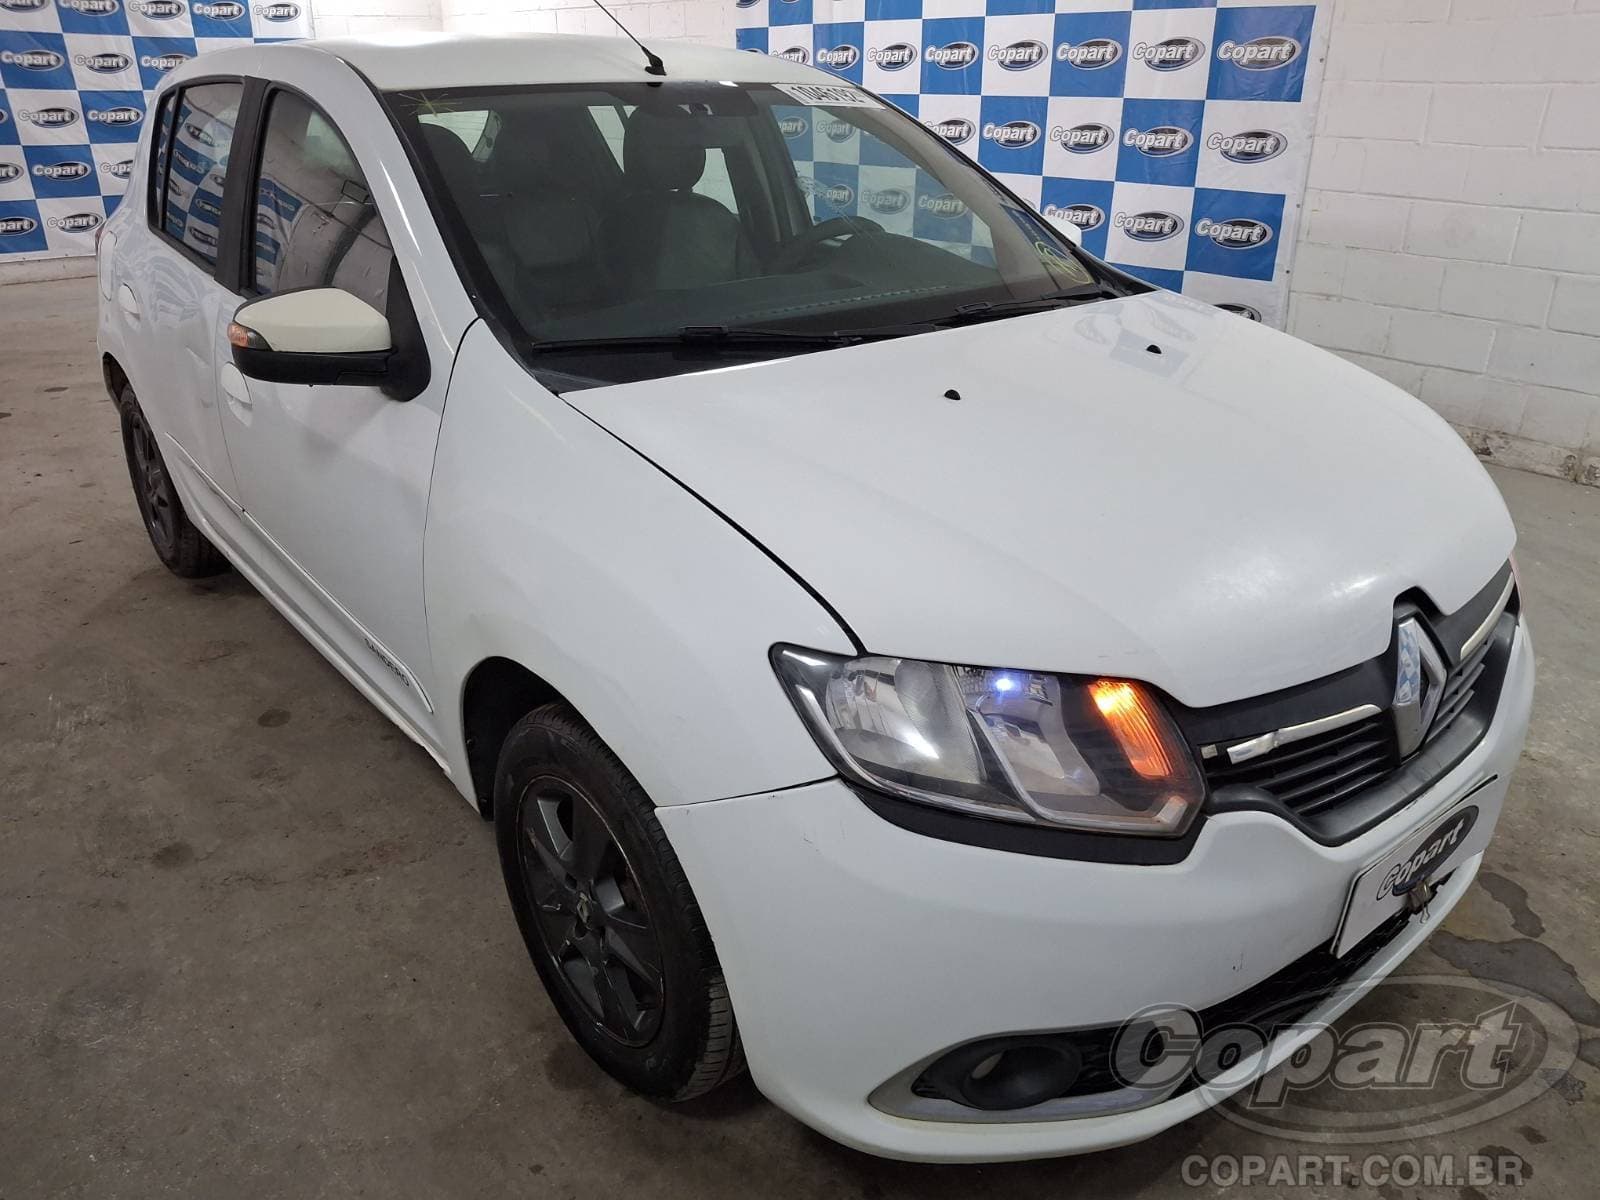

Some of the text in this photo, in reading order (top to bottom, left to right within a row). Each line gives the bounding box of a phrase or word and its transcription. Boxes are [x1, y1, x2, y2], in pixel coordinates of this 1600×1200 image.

[129, 1, 178, 14] Copart
[193, 3, 239, 16] Copart
[254, 4, 296, 17] Copart
[2, 51, 58, 66] Copart
[74, 54, 125, 68] Copart
[817, 47, 853, 66] Copart
[867, 47, 910, 65] Copart
[925, 44, 972, 65] Copart
[988, 44, 1040, 64] Copart
[1056, 42, 1114, 64] Copart
[1132, 42, 1193, 63] Copart
[1217, 40, 1291, 64] Copart
[19, 110, 72, 124] Copart
[87, 110, 138, 123] Copart
[983, 123, 1034, 142] Copart
[1050, 126, 1106, 144] Copart
[1123, 128, 1185, 150] Copart
[1207, 132, 1276, 155] Copart
[33, 164, 84, 177] Copart
[919, 194, 965, 211] Copart
[47, 215, 95, 229] Copart
[1113, 211, 1174, 233] Copart
[1195, 217, 1265, 242] Copart
[1376, 818, 1465, 901] Copart
